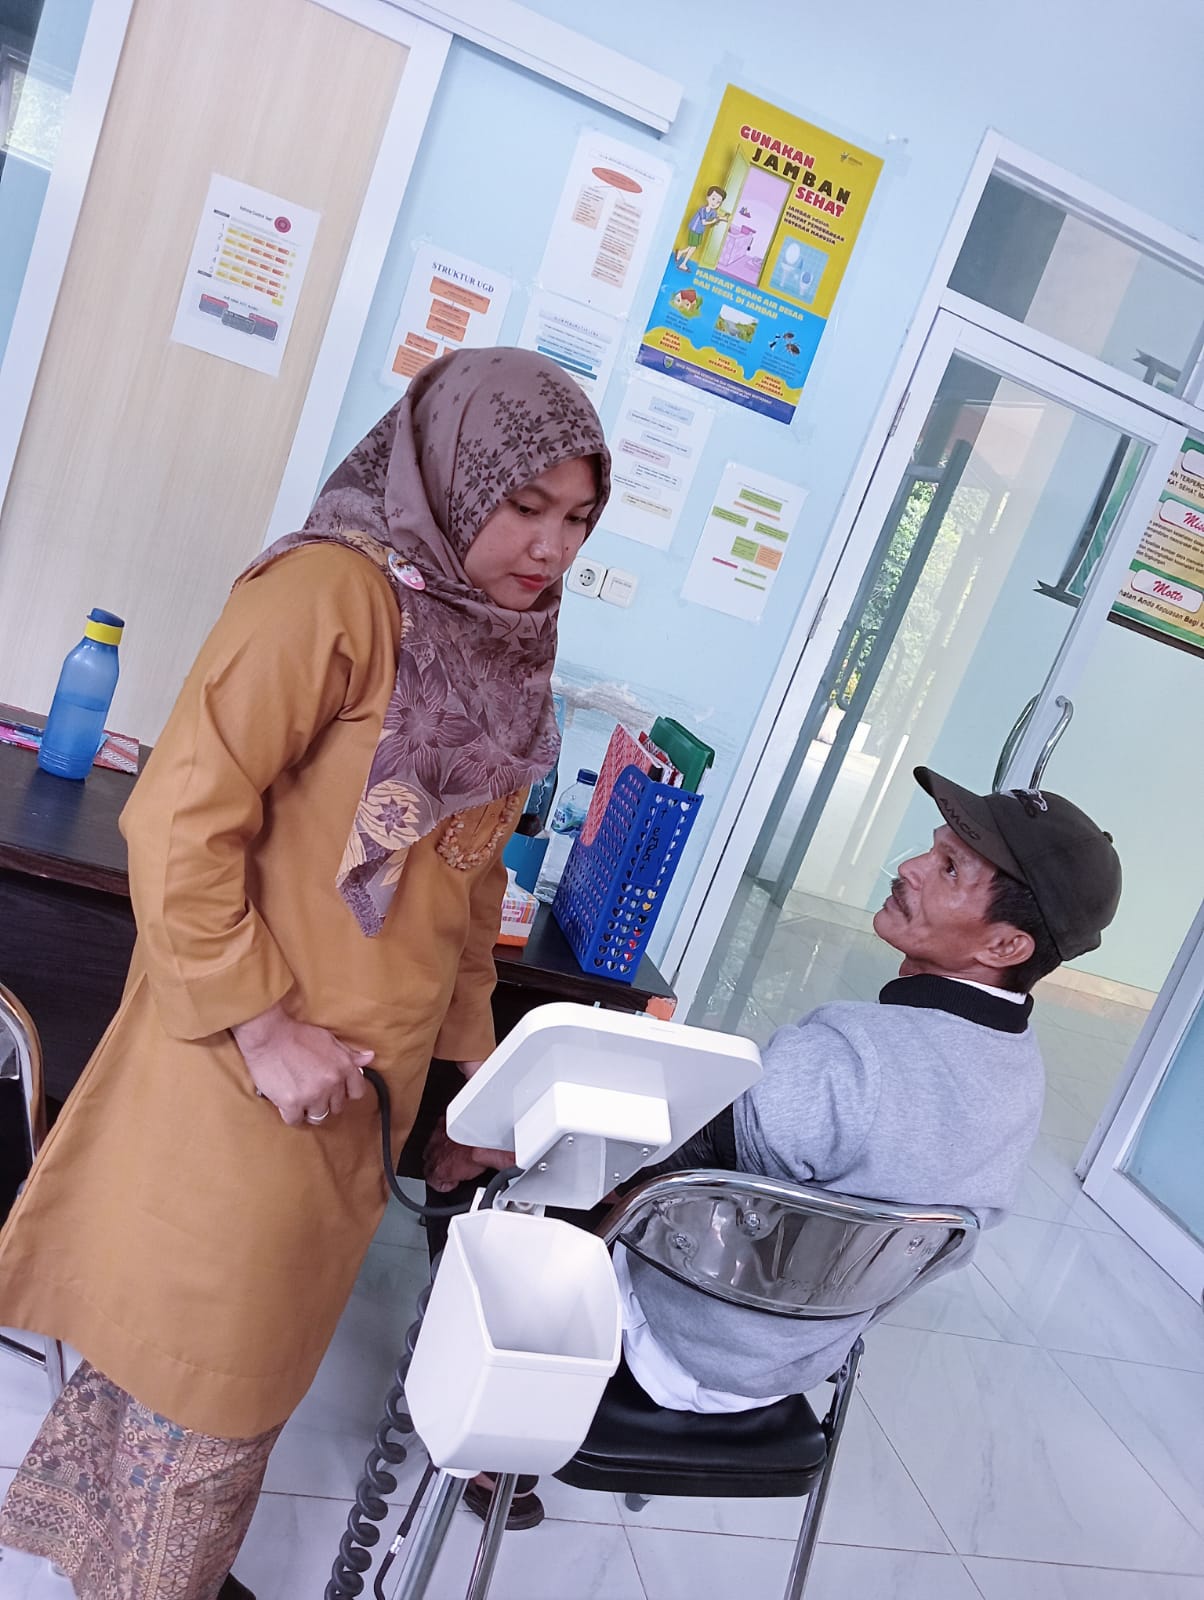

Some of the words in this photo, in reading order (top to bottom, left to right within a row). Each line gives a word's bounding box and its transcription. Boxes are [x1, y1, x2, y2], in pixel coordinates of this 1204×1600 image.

[740, 125, 815, 169] GUNAKAN
[752, 147, 851, 205] JAMBAN
[795, 186, 845, 218] SEHAT
[432, 261, 476, 285] STRUKTUR
[477, 280, 495, 292] UGD
[763, 298, 778, 309] AIR
[1153, 580, 1184, 601] Motto
